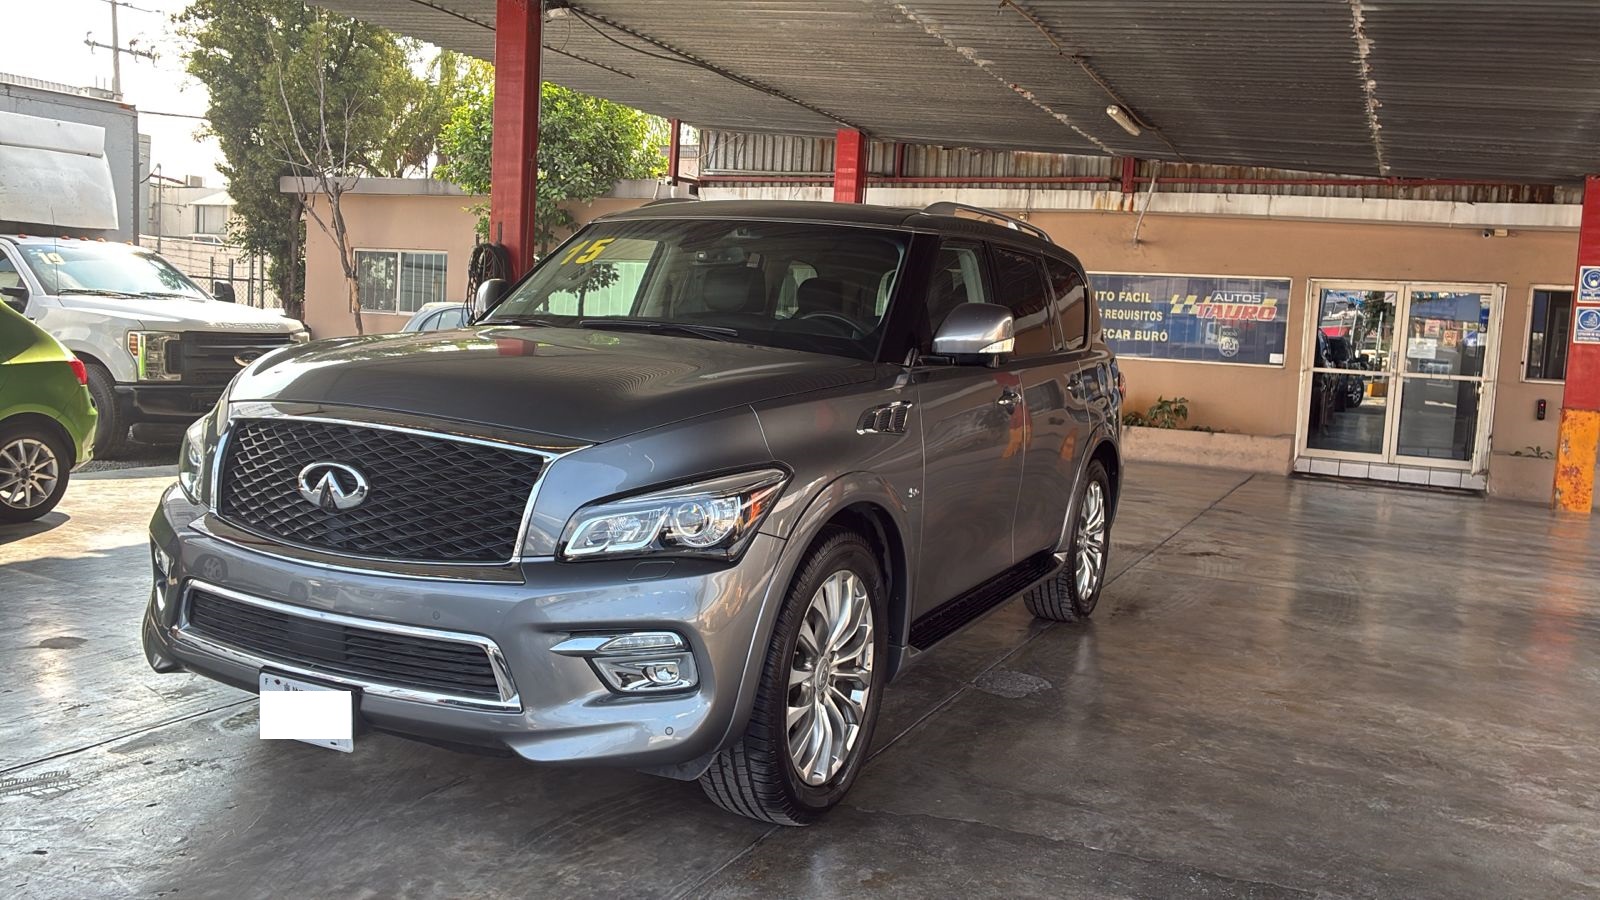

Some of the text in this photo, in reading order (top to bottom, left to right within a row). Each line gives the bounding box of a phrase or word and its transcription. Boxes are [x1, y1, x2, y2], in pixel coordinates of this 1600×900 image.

[560, 237, 616, 265] 15
[37, 252, 66, 265] 19
[1095, 290, 1152, 303] ITO FACIL
[1213, 292, 1262, 303] AUTOS
[1105, 308, 1163, 322] REQUISITOS
[1196, 303, 1278, 321] TAURO
[1102, 328, 1131, 340] ECAR
